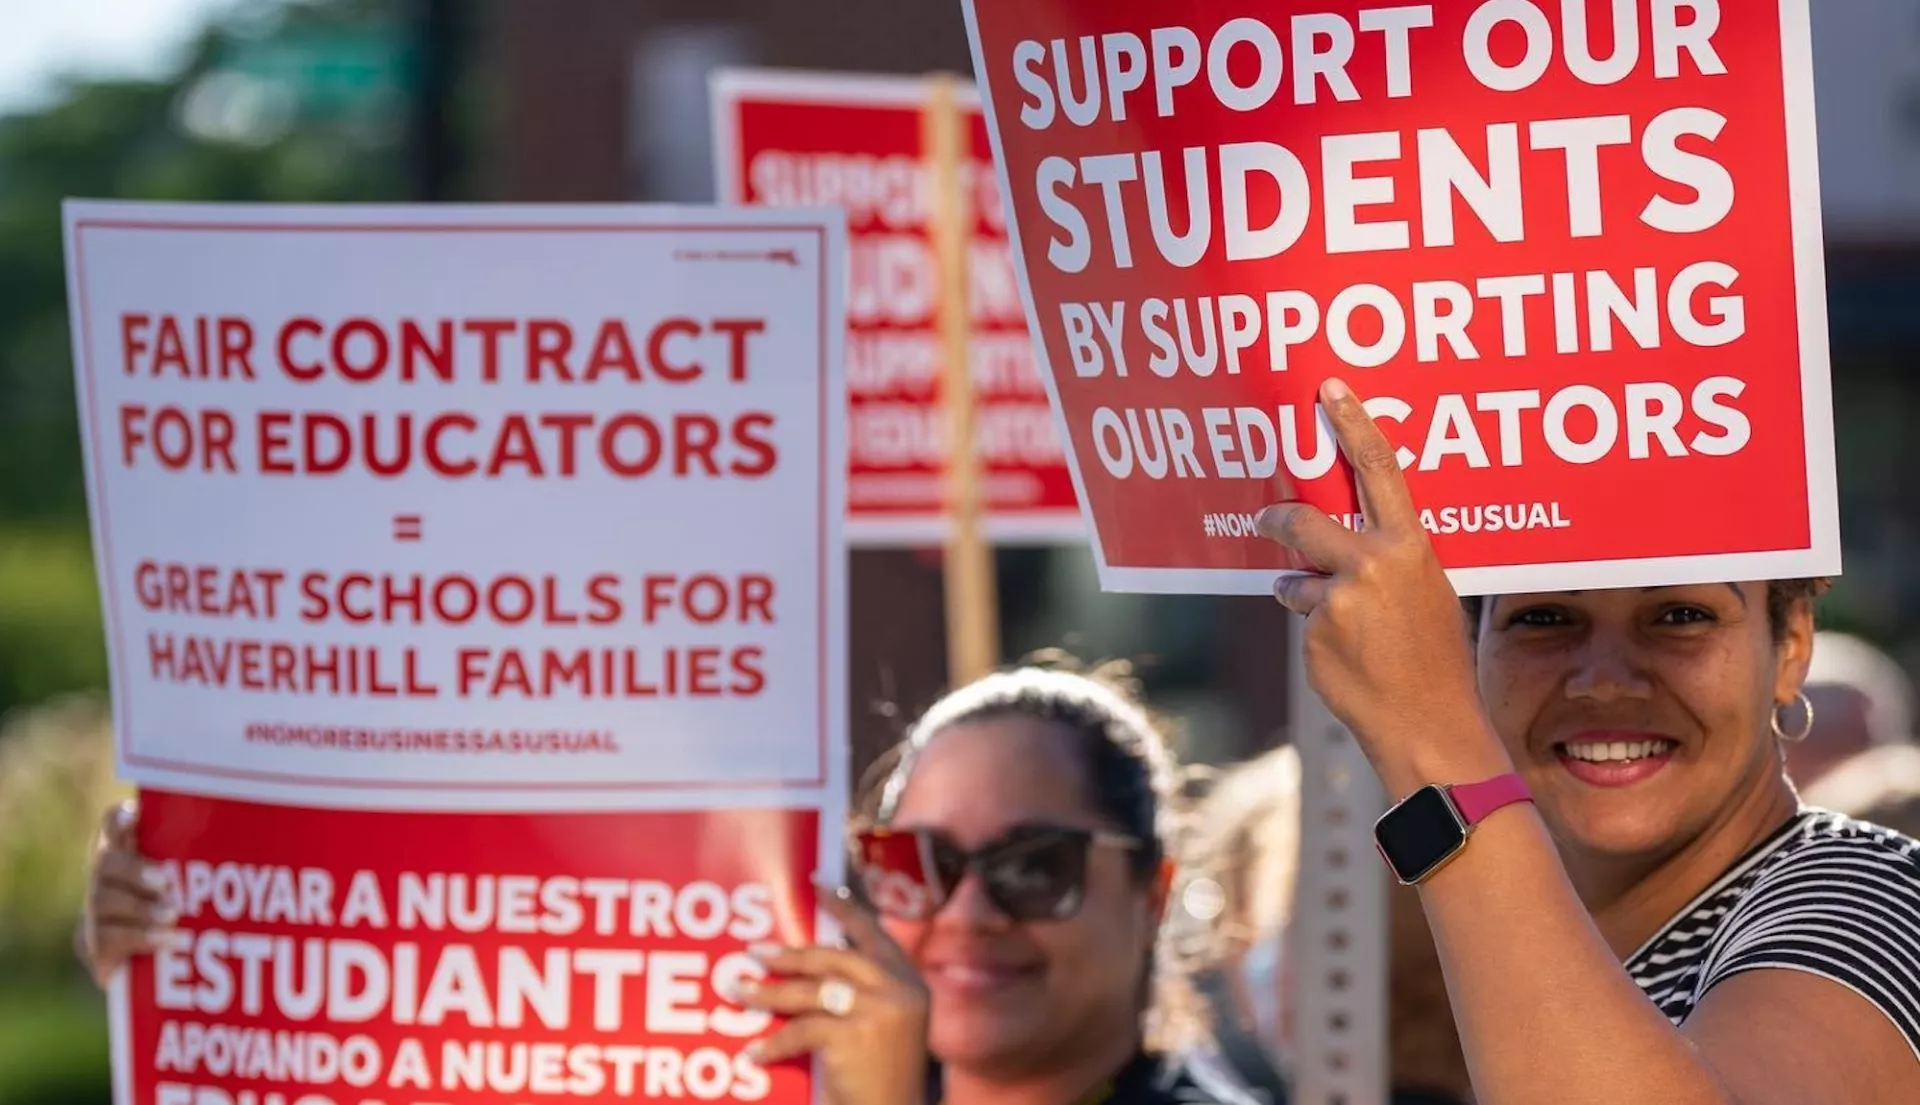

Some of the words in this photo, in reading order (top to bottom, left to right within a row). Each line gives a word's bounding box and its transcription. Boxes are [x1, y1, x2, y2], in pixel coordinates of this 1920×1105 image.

[1013, 6, 1433, 131] SUPPORT
[1462, 0, 1728, 92] OUR
[1035, 107, 1735, 273] STUDENTS
[121, 314, 256, 380] FAIR
[277, 317, 766, 383] CONTRACT
[1060, 301, 1128, 378] BY
[1141, 261, 1745, 377] SUPPORTING
[120, 405, 238, 473] FOR
[257, 412, 777, 478] EDUCATORS
[1091, 406, 1205, 480] OUR
[393, 515, 422, 541] =
[1203, 501, 1570, 538] #NOMASUSUAL
[134, 561, 284, 619] GREAT
[300, 571, 623, 625] SCHOOLS
[643, 575, 775, 624] FOR
[148, 631, 439, 695] HAVERHILL
[457, 647, 767, 697] FAMILIES
[244, 722, 618, 753] #NOMOREBUSINESSASUSUAL
[341, 870, 388, 928] A
[398, 873, 773, 940] NUESTROS
[153, 929, 773, 1037] ESTUDIANTES
[155, 1020, 380, 1085] APOYANDO
[388, 1038, 435, 1087] A
[443, 1039, 771, 1100] NUESTROS
